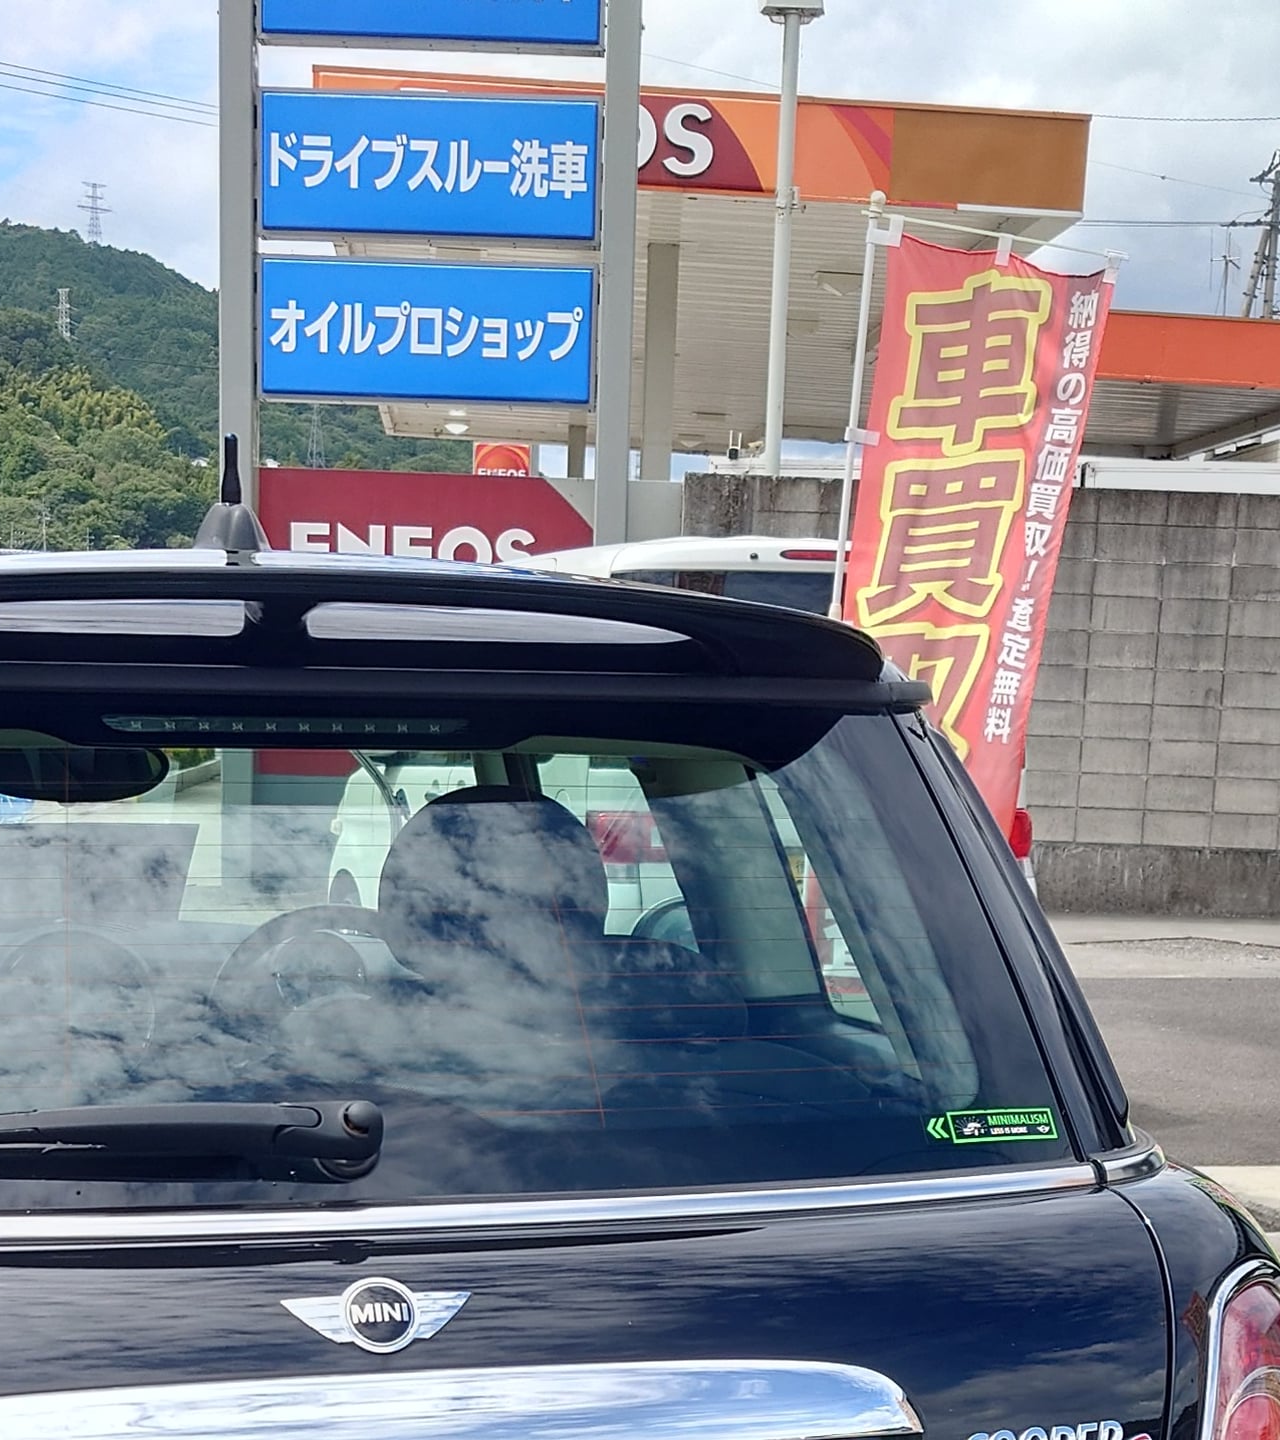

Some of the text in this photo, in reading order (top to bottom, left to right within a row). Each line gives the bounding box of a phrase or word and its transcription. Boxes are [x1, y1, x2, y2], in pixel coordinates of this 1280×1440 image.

[269, 132, 589, 199] ドライブスルー洗車
[269, 300, 584, 361] オイルプロショップ
[987, 1114, 1049, 1126] MINIMALISM
[350, 1302, 409, 1325] MINI
